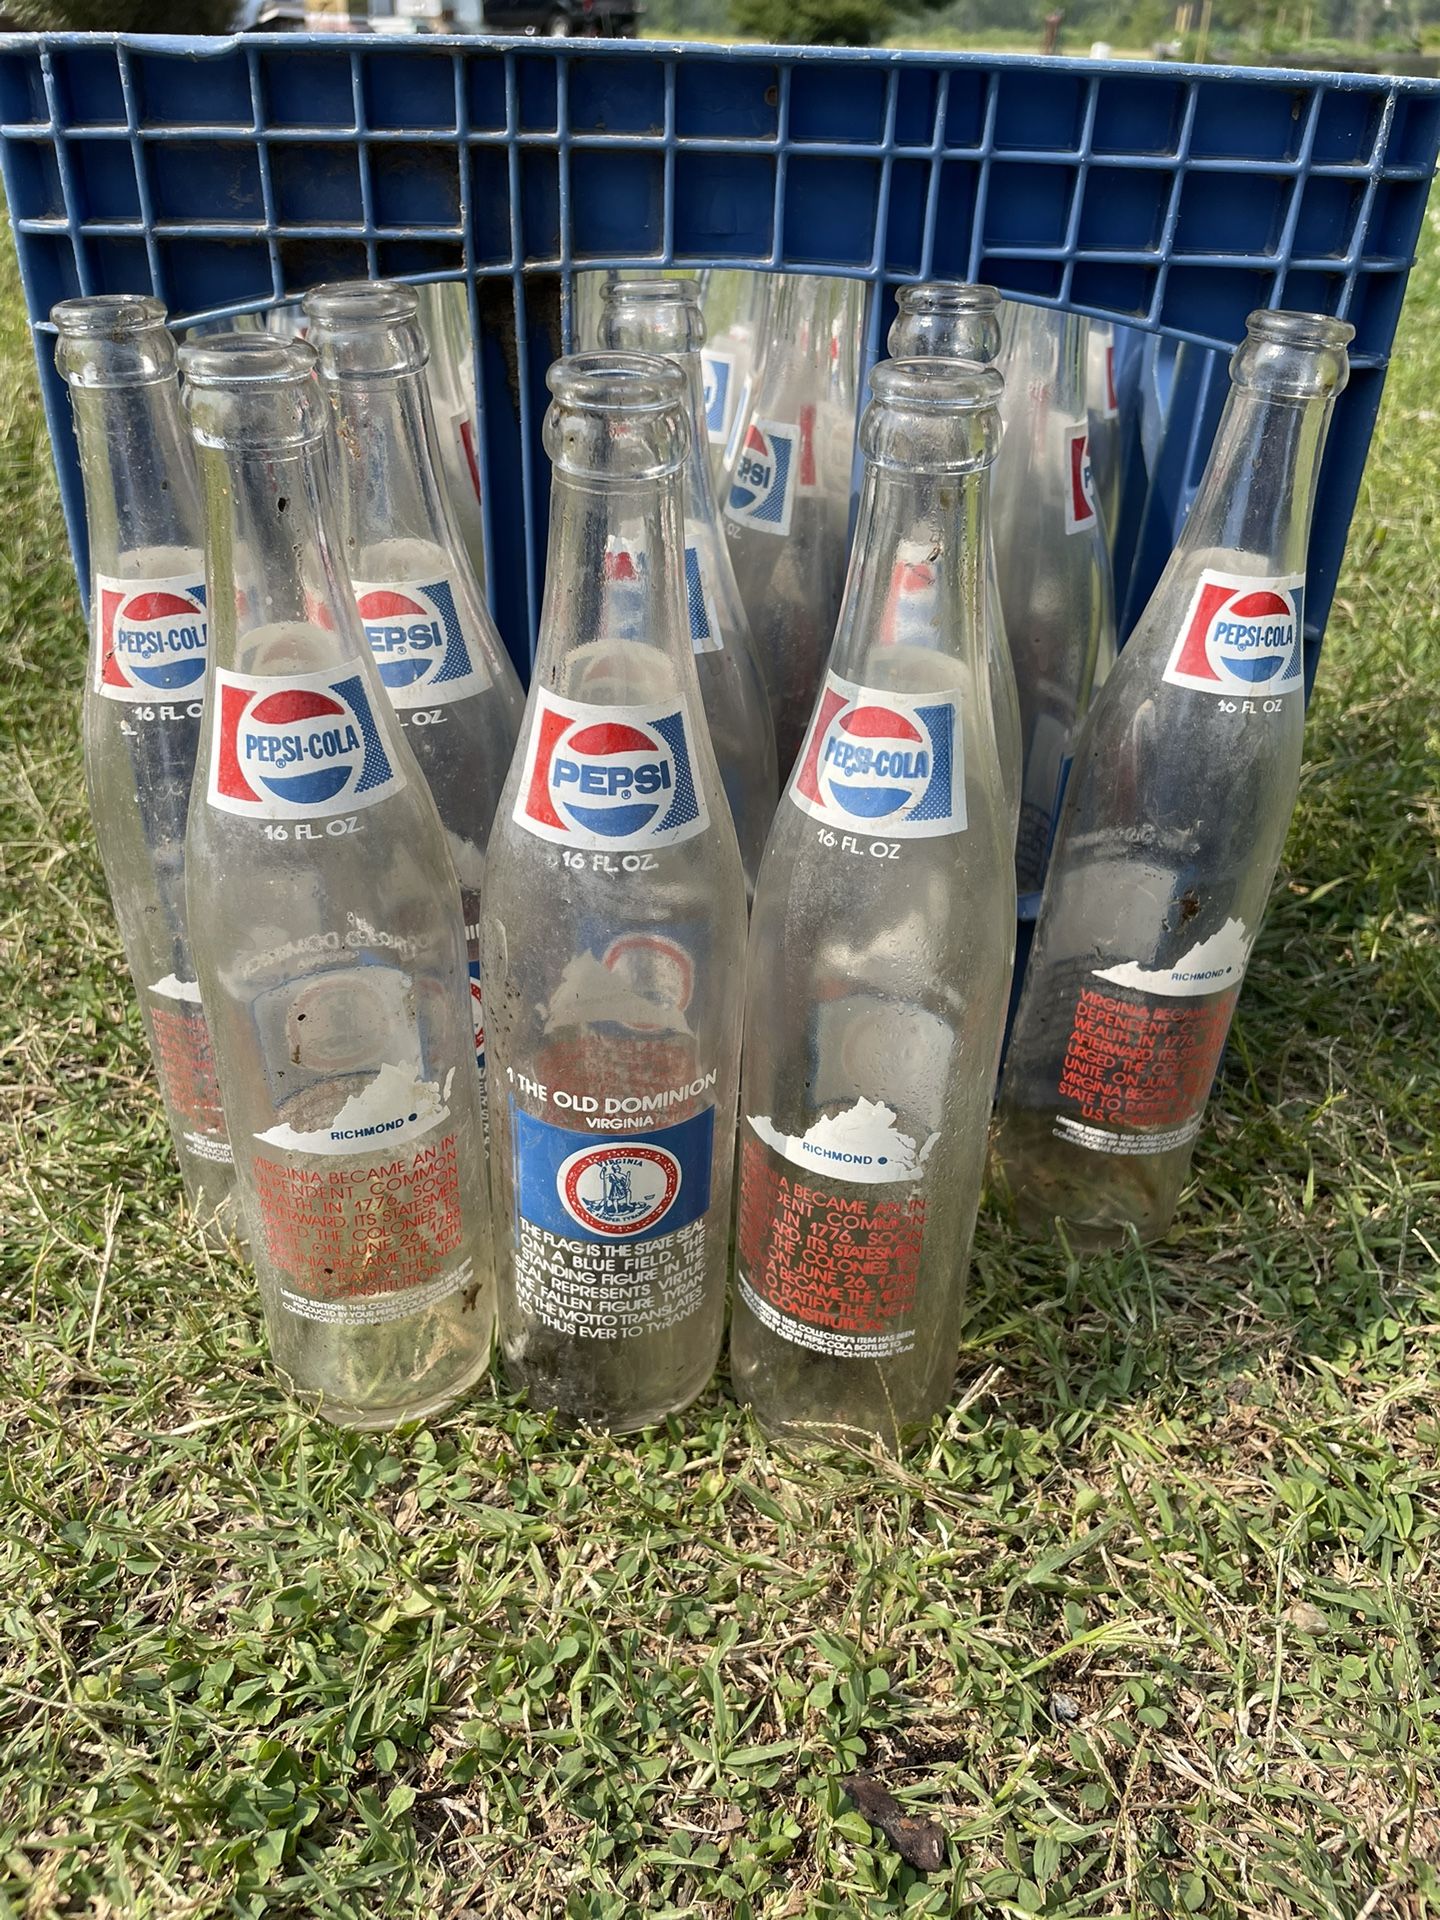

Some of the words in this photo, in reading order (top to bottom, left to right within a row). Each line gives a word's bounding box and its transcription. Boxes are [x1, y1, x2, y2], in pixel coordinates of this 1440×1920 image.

[365, 621, 443, 652] EPSI
[1213, 622, 1293, 649] PEPSI-COLA
[134, 706, 155, 721] 16
[186, 703, 203, 718] O
[1217, 699, 1237, 713] 16
[246, 725, 360, 762] PEPSI-COLA
[824, 735, 930, 779] PEPSI-COLA
[552, 759, 673, 796] PEPSI
[264, 825, 289, 841] 16
[841, 835, 865, 856] FL.
[869, 841, 902, 859] OZ
[562, 851, 586, 869] 16
[1171, 967, 1225, 981] RICHMOND
[1076, 1001, 1169, 1034] DEPENDENT
[1081, 987, 1150, 1019] VIRGINIA
[1075, 1015, 1130, 1043] WEALTH
[1138, 1034, 1156, 1048] IN
[1067, 1042, 1116, 1068] URGED
[1122, 1060, 1147, 1073] THE
[517, 1073, 548, 1102] THE
[552, 1090, 599, 1113] OLD
[604, 1068, 718, 1114] DOMINION
[1058, 1081, 1095, 1105] STATE
[1100, 1095, 1121, 1110] TO
[1063, 1067, 1122, 1097] VIRGINIA
[1112, 1072, 1139, 1086] ON
[1141, 1076, 1177, 1088] JUNE
[331, 1118, 405, 1141] RICHMOND
[585, 1116, 655, 1130] VIRGINIA
[255, 1156, 323, 1184] VIRGINIA
[328, 1160, 406, 1185] BECAME
[413, 1146, 436, 1168] AN
[594, 1158, 644, 1168] VIRGINIA
[802, 1141, 873, 1165] RICHMOND
[323, 1202, 342, 1213] IN
[413, 1162, 457, 1198] SOON
[354, 1213, 376, 1227] ITS
[382, 1177, 459, 1223] STATESMEN
[793, 1183, 868, 1215] BECAME
[873, 1202, 902, 1216] AN
[316, 1229, 343, 1241] THE
[352, 1207, 437, 1241] COLONIES
[443, 1191, 460, 1210] TO
[783, 1209, 800, 1228] IN
[867, 1228, 923, 1246] SOON
[312, 1242, 340, 1254] ON
[347, 1237, 392, 1256] JUNE
[332, 1249, 400, 1270] BECAME
[405, 1239, 430, 1257] THE
[435, 1220, 461, 1244] 10TH
[520, 1216, 542, 1240] THE
[543, 1231, 584, 1254] FLAG
[586, 1244, 601, 1257] IS
[602, 1244, 632, 1257] THE
[634, 1234, 675, 1255] STATE
[676, 1218, 706, 1243] SEAL
[521, 1233, 545, 1256] ON
[551, 1250, 565, 1265] A
[572, 1255, 616, 1271] BLUE
[624, 1250, 675, 1271] FIELD.
[681, 1229, 706, 1254] THE
[773, 1231, 796, 1256] THE
[802, 1249, 890, 1275] COLONIES
[806, 1235, 828, 1253] ITS
[832, 1243, 921, 1260] STATESMEN
[401, 1256, 425, 1273] THE
[432, 1234, 462, 1260] NEW
[522, 1246, 597, 1284] STANDING
[601, 1268, 658, 1285] FIGURE
[664, 1260, 680, 1276] IN
[684, 1243, 705, 1264] THE
[767, 1245, 790, 1268] ON
[794, 1261, 838, 1285] JUNE
[515, 1254, 545, 1284] SEAL
[551, 1277, 651, 1299] REPRESENTS
[658, 1257, 706, 1290] VIRTUE
[515, 1267, 535, 1292] THE
[540, 1285, 592, 1312] FALLEN
[599, 1296, 655, 1312] FIGURE
[780, 1266, 844, 1300] BECAME
[848, 1289, 877, 1304] THE
[515, 1281, 533, 1303] NY.
[533, 1294, 557, 1316] THE
[558, 1307, 618, 1326] MOTTO
[619, 1285, 702, 1325] TRANSLATES
[516, 1294, 533, 1315] TO
[579, 1326, 618, 1339] EVER
[620, 1325, 643, 1339] TO
[781, 1283, 833, 1310] RATIFY
[838, 1303, 870, 1318] THE
[776, 1327, 794, 1342] OUR
[794, 1337, 833, 1355] NATION'S
[803, 1333, 853, 1351] PEPSI-COLA
[889, 1340, 902, 1348] TO
[856, 1336, 877, 1344] ITEM
[878, 1334, 896, 1343] HAS
